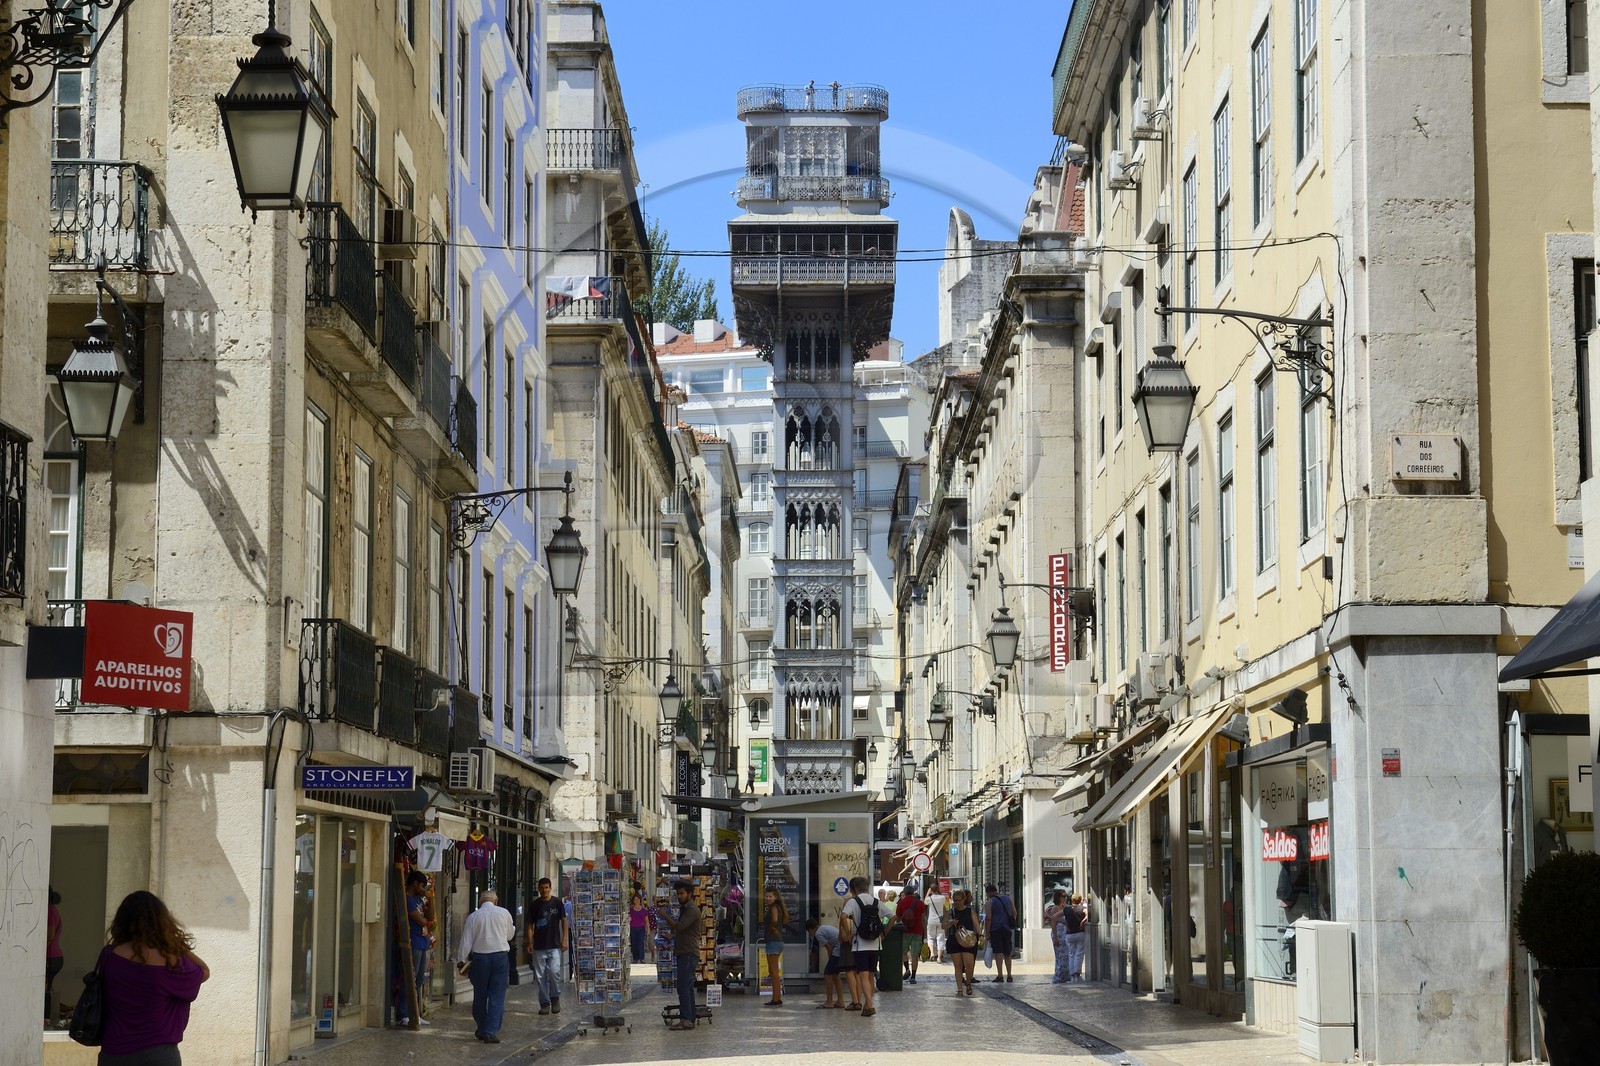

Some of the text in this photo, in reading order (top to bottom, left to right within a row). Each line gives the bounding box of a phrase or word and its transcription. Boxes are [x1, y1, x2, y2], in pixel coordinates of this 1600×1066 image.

[1419, 440, 1433, 449] RUA
[1419, 452, 1433, 461] DOS
[1406, 464, 1445, 473] CORREEIROS
[1052, 556, 1067, 671] PENHORES
[95, 660, 182, 679] APARELHOS
[94, 675, 182, 694] AUDITIVOS
[306, 769, 408, 782] STONEFLY
[1261, 783, 1296, 807] FABRIKA
[759, 837, 791, 845] LISBON
[759, 845, 785, 853] WEEK
[1263, 832, 1298, 859] Saldos
[424, 846, 436, 869] 7
